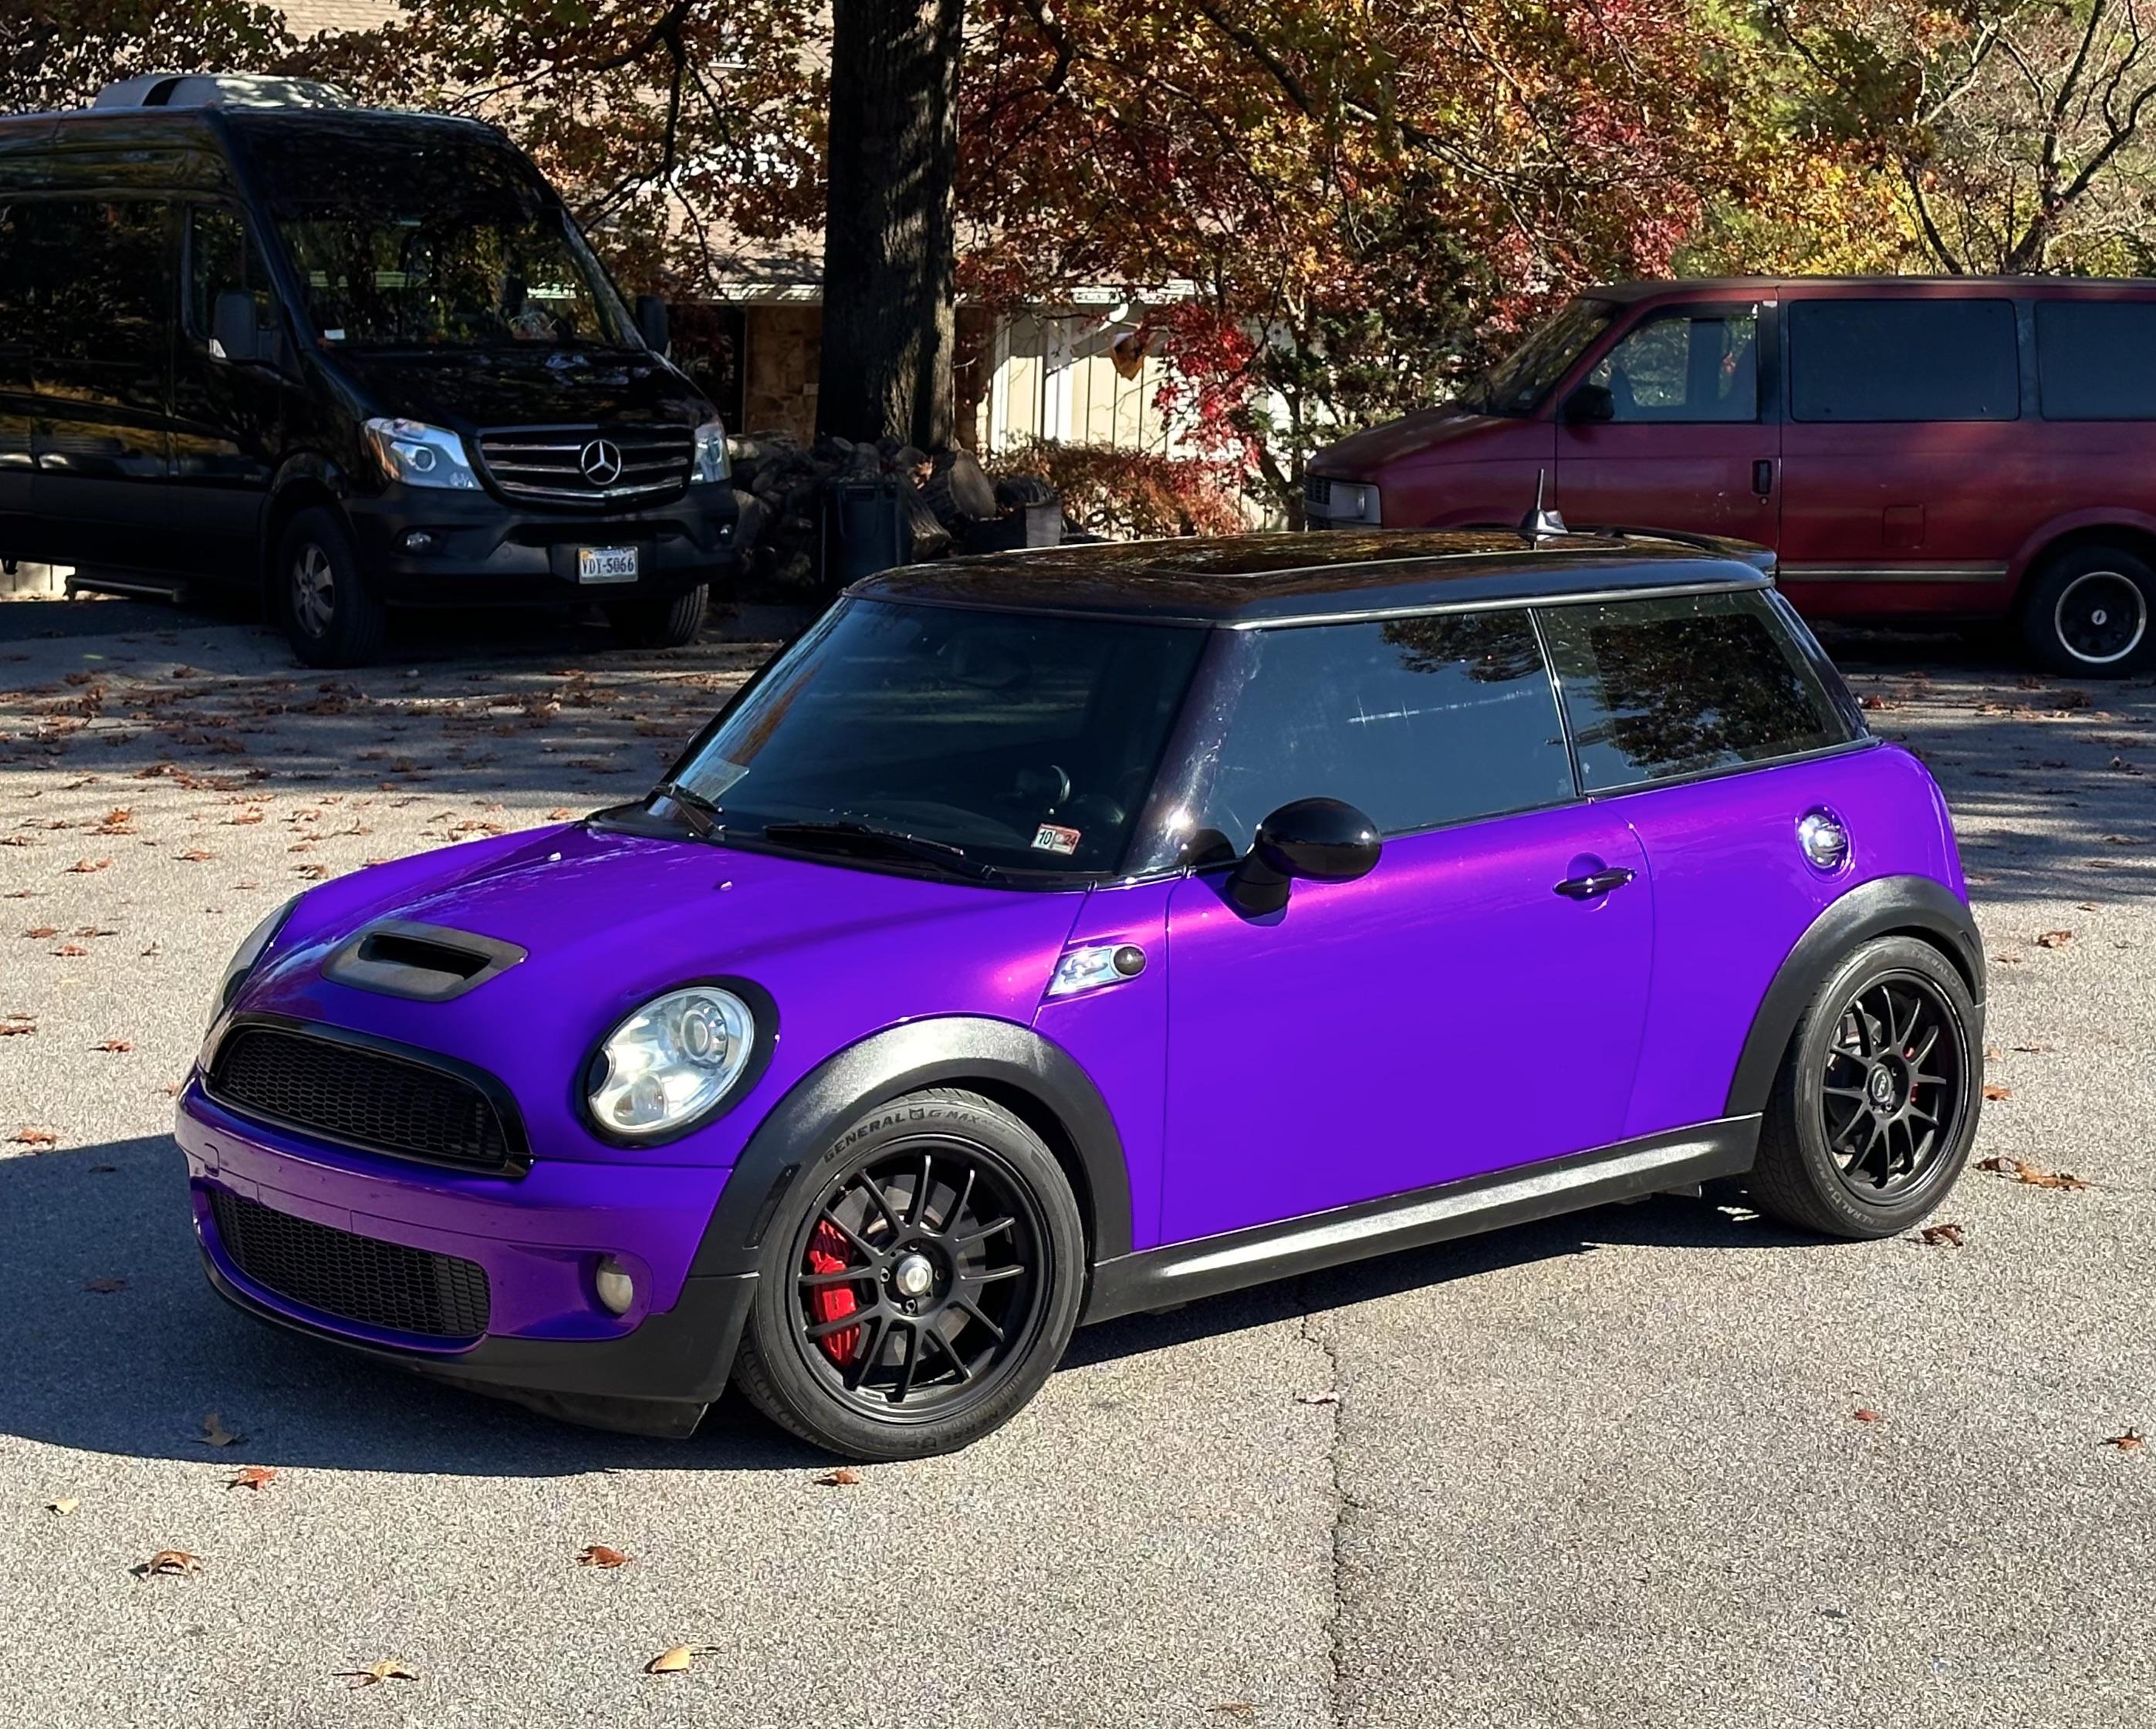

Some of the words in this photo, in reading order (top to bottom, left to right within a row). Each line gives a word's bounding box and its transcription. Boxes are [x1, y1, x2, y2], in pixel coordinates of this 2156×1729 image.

[1039, 830, 1053, 845] 10
[1064, 834, 1077, 847] 24
[823, 1112, 905, 1163] GENERAL
